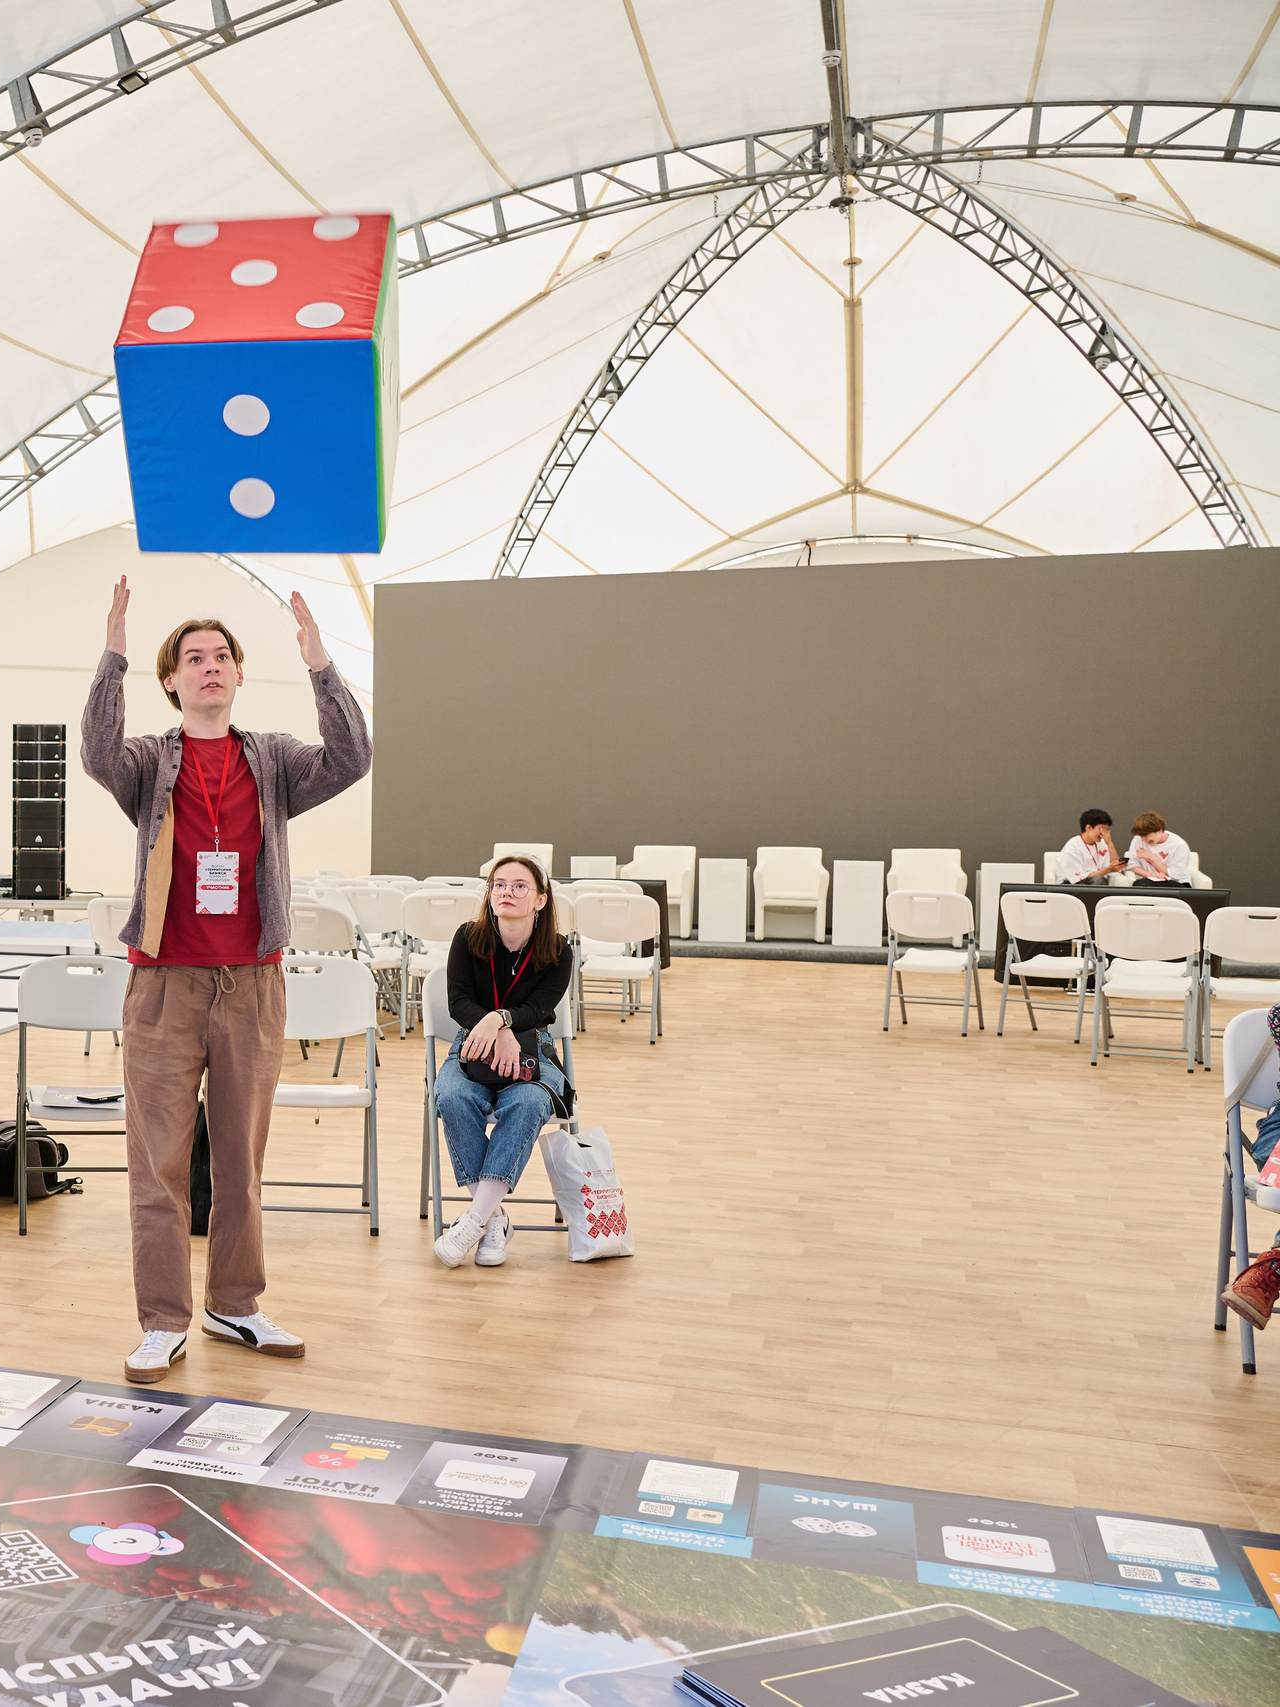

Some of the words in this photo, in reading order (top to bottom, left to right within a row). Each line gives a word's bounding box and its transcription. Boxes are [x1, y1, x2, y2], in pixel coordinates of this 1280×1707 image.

[84, 1396, 162, 1416] КАЗНА
[349, 1438, 402, 1449] ЗАПЛАТИ
[151, 1460, 244, 1476] «ПРАВИЛЬНЫЕ
[177, 1459, 225, 1469] ТРАВЫ»
[283, 1482, 375, 1497] ПОДОХОДНЫЙ
[284, 1475, 380, 1492] НАЛОГ
[418, 1500, 523, 1518] КОНДИТЕРСКАЯ
[442, 1499, 503, 1510] ФАБРИКА
[793, 1495, 877, 1512] ШАНС
[621, 1523, 727, 1543] ТРАДИЦИЯ»
[622, 1528, 722, 1548] «ТУЛЬСКАЯ
[948, 1573, 1060, 1592] «ТУЛЬСКАЯ
[951, 1568, 1056, 1588] ГАРМОНЬ»
[956, 1580, 1055, 1598] ФАБРИКА
[1118, 1594, 1223, 1612] «МАШЗАВОД
[1140, 1602, 1235, 1619] САМОВАРЫ
[1150, 1609, 1235, 1625] ТУЛЬСКИЕ
[32, 1658, 261, 1707] УДАЧУ!
[862, 1672, 975, 1703] КАЗНА
